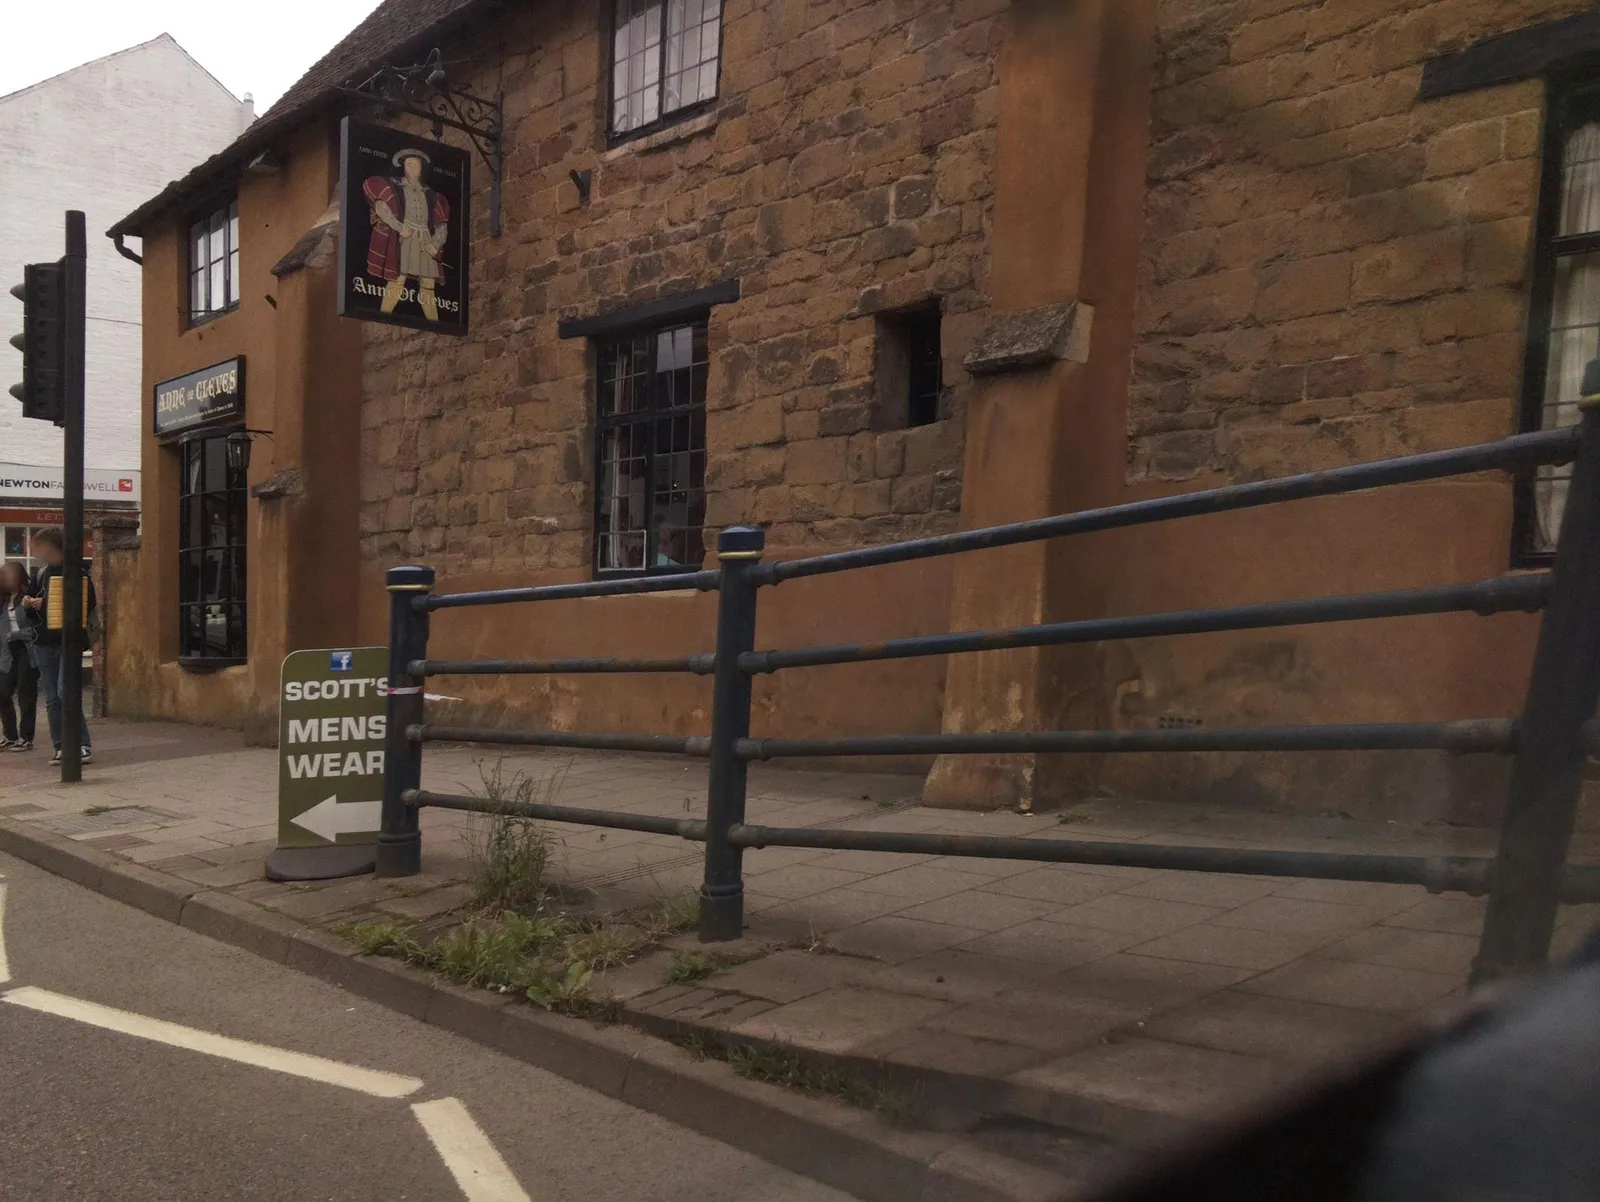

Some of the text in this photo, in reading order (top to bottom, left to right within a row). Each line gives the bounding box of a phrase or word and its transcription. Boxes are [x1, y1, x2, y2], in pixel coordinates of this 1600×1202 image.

[352, 276, 460, 312] Anne Of Cleves
[196, 369, 236, 402] CLEVES
[285, 677, 389, 701] SCOTT'S
[288, 715, 387, 744] MENS
[287, 750, 385, 779] WEAR
